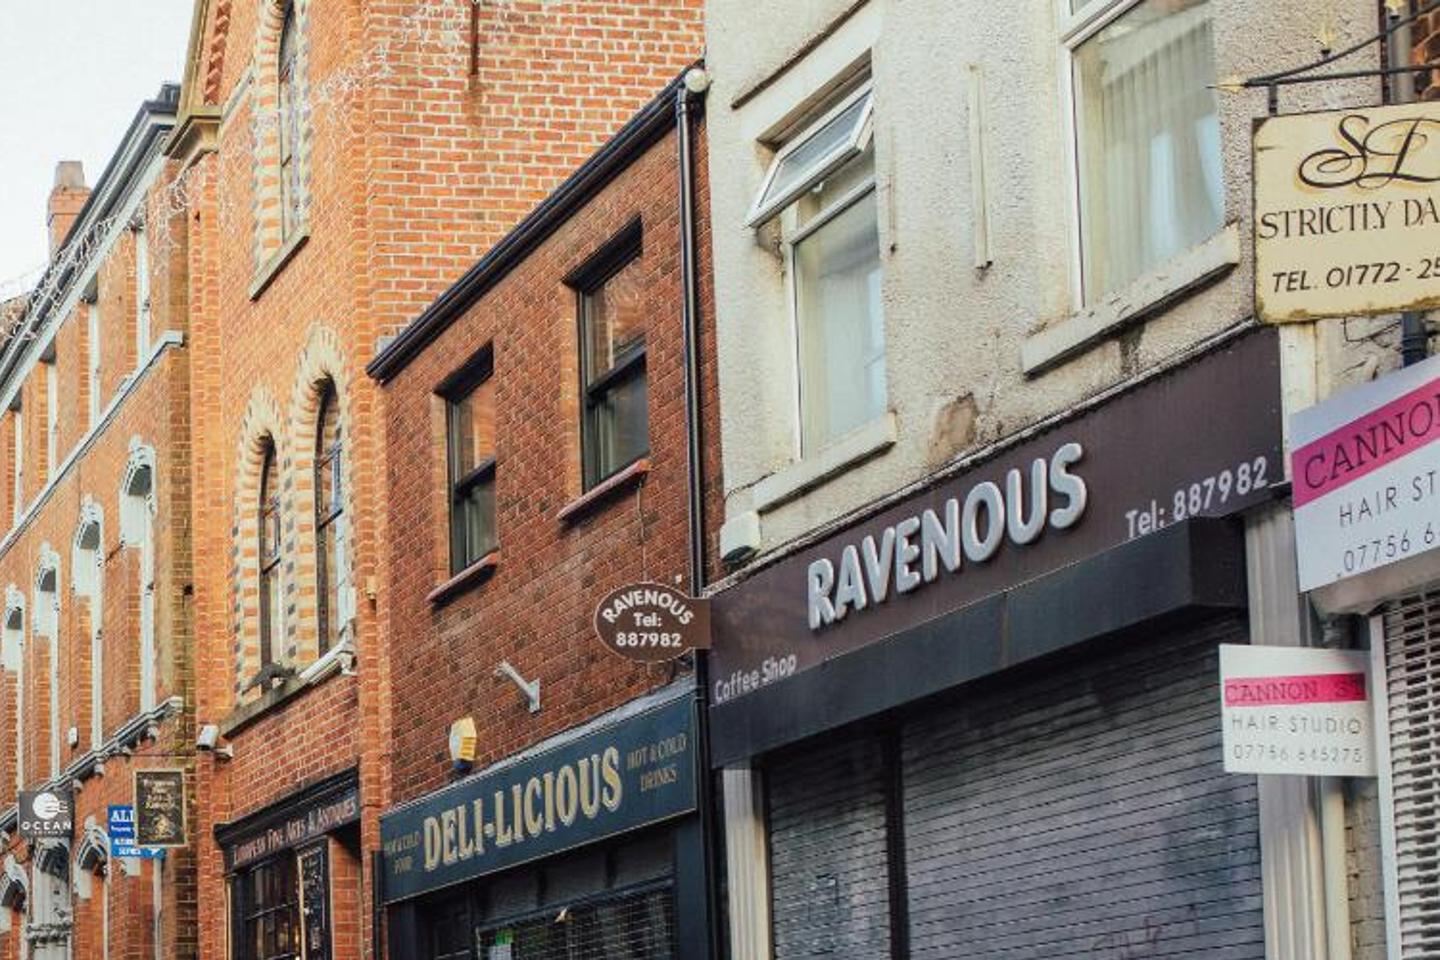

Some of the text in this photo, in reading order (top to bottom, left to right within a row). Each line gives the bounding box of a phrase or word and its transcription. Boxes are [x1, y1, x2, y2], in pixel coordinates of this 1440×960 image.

[1259, 201, 1391, 239] STRICTLY
[1127, 455, 1268, 540] Tel: 887982
[1339, 486, 1398, 527] HAIR
[807, 441, 1087, 630] RAVENOUS
[602, 589, 694, 625] RAVENOUS
[633, 612, 663, 627] Tel:
[615, 632, 683, 647] 887982
[715, 653, 797, 705] Coffee Shop
[1224, 680, 1318, 703] CANNON
[1232, 713, 1361, 734] HAIR STUDIO
[21, 820, 72, 831] OCEAN
[423, 746, 623, 872] DELI-LICIOUS
